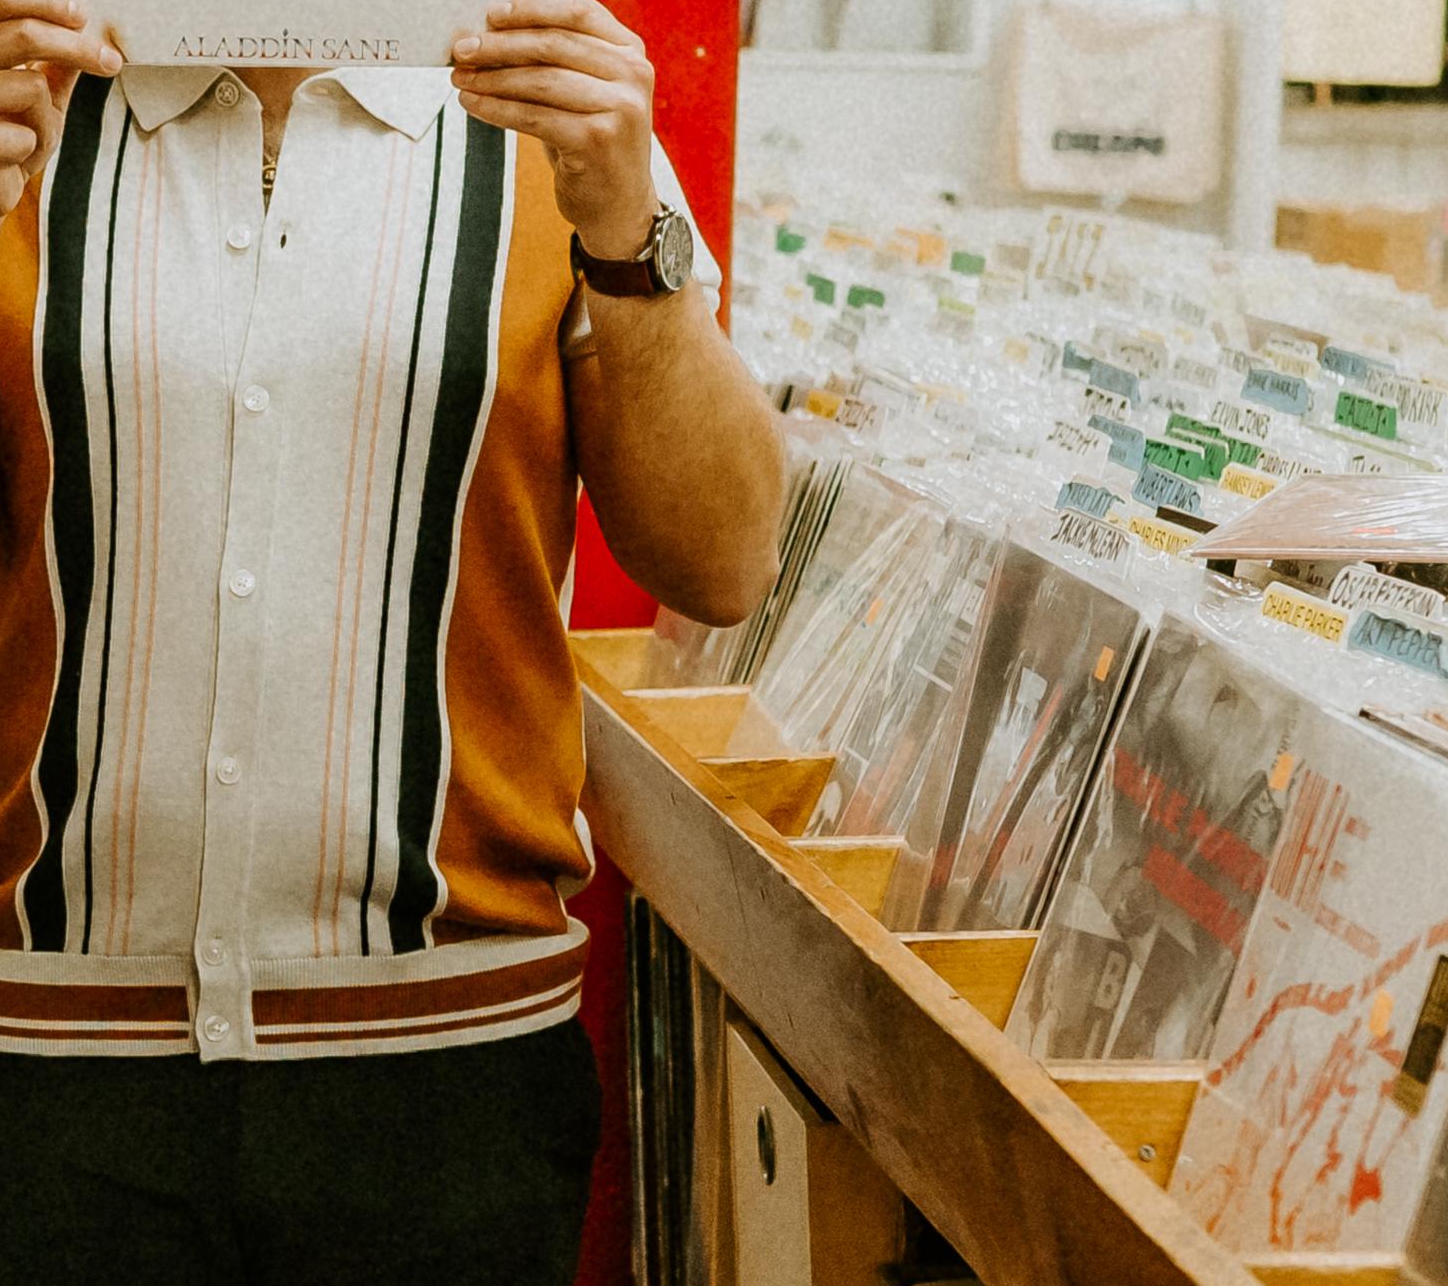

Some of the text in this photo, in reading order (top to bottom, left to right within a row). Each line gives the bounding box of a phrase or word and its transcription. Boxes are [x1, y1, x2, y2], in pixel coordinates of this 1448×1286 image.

[321, 37, 400, 61] SANE
[1332, 571, 1374, 609] OSCAR
[1262, 592, 1344, 644] CHARLIE PARKER
